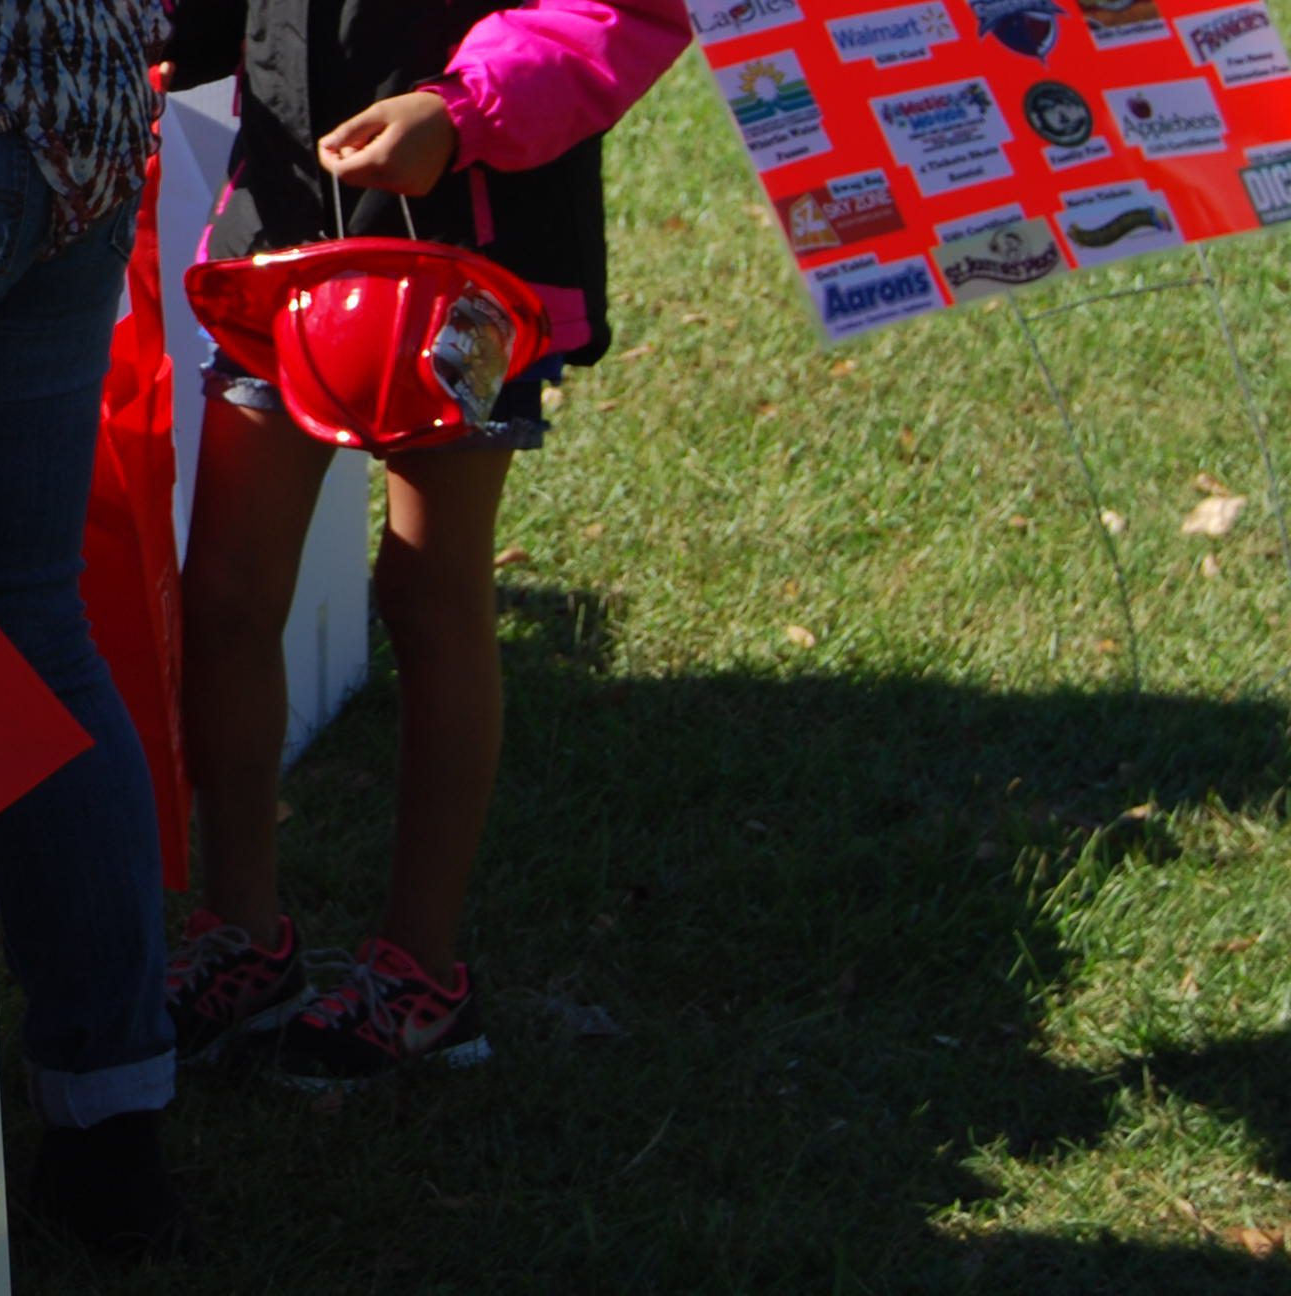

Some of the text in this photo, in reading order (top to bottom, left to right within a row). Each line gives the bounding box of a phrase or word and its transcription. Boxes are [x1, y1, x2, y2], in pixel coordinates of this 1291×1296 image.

[833, 17, 922, 51] Walmart
[823, 198, 851, 219] SKY
[853, 190, 893, 212] ZONE
